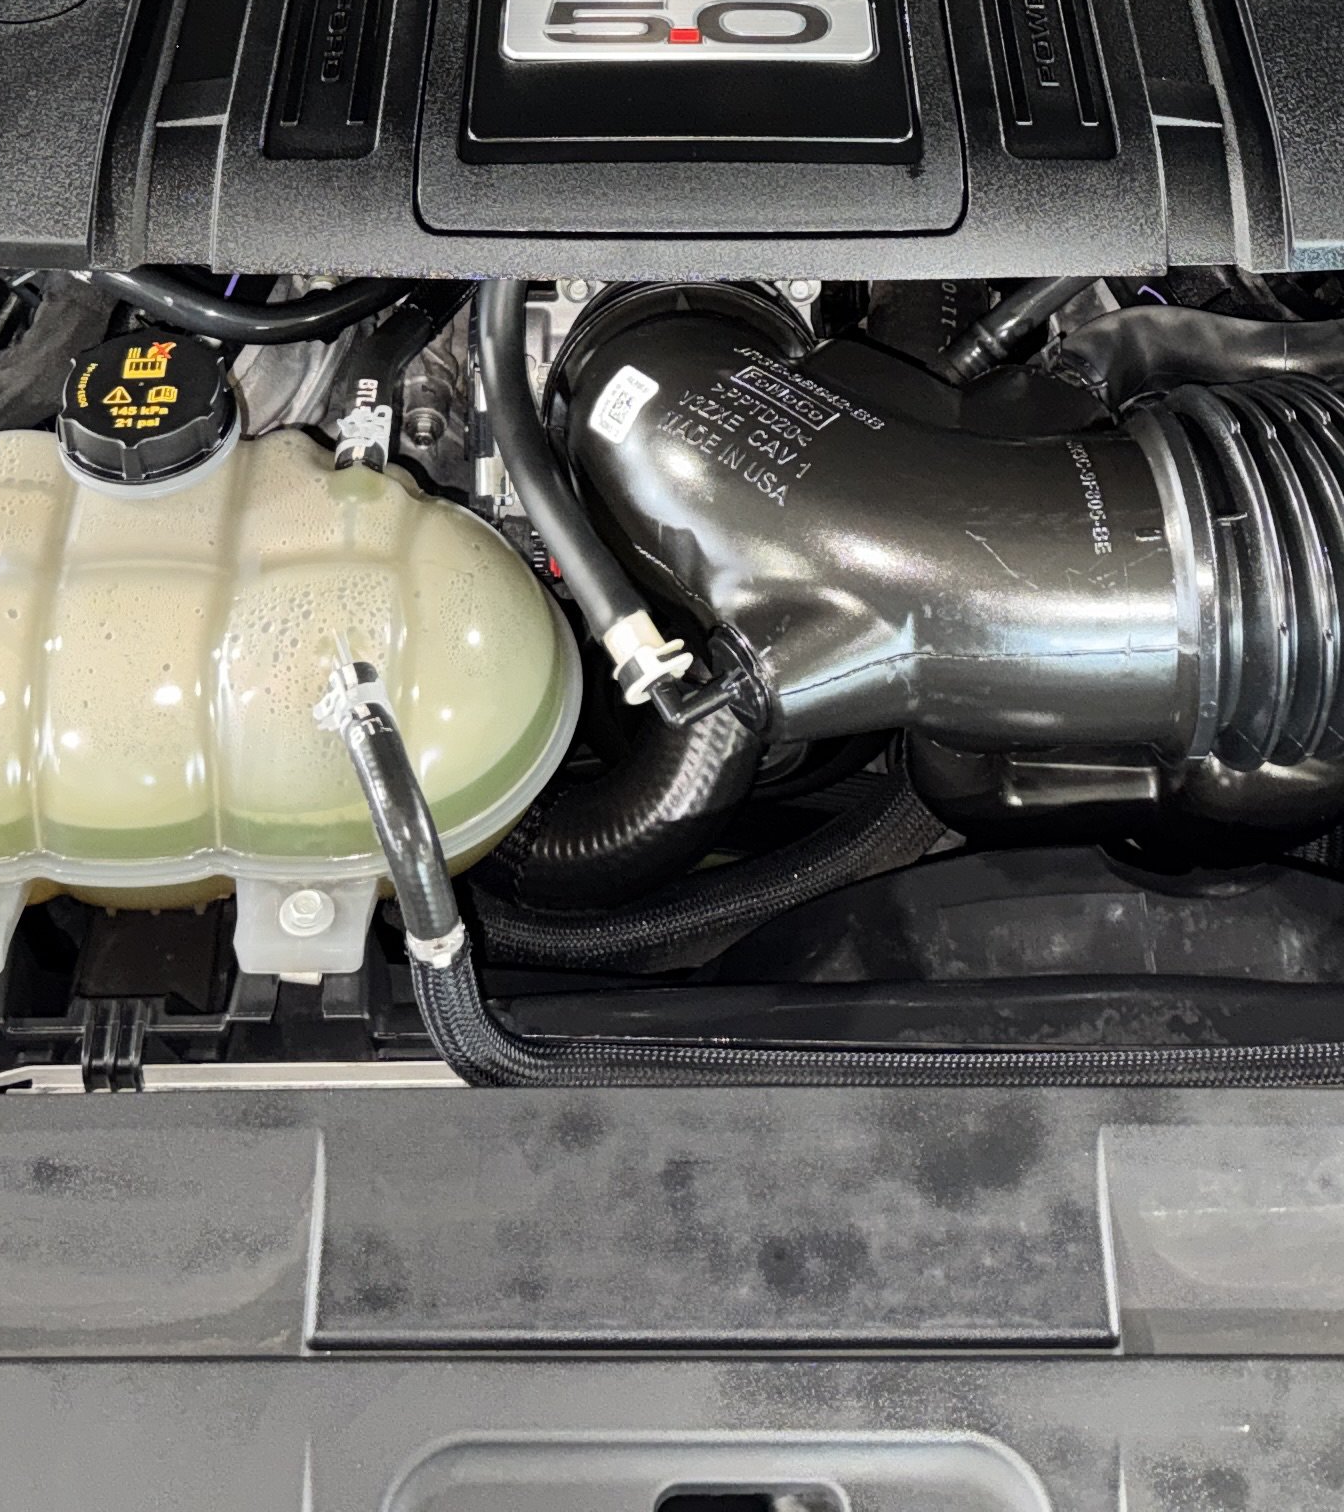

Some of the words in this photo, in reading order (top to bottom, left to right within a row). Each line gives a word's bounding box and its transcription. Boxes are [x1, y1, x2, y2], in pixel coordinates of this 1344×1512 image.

[542, 0, 832, 45] 5.0
[109, 406, 138, 416] 145
[140, 405, 169, 415] kPa
[743, 371, 823, 421] FoMoCo
[114, 418, 133, 428] 21
[136, 417, 160, 429] psi
[658, 411, 723, 454] MADE
[718, 443, 747, 470] IN
[743, 462, 789, 507] USA
[748, 429, 798, 465] CAV
[796, 462, 812, 479] 1
